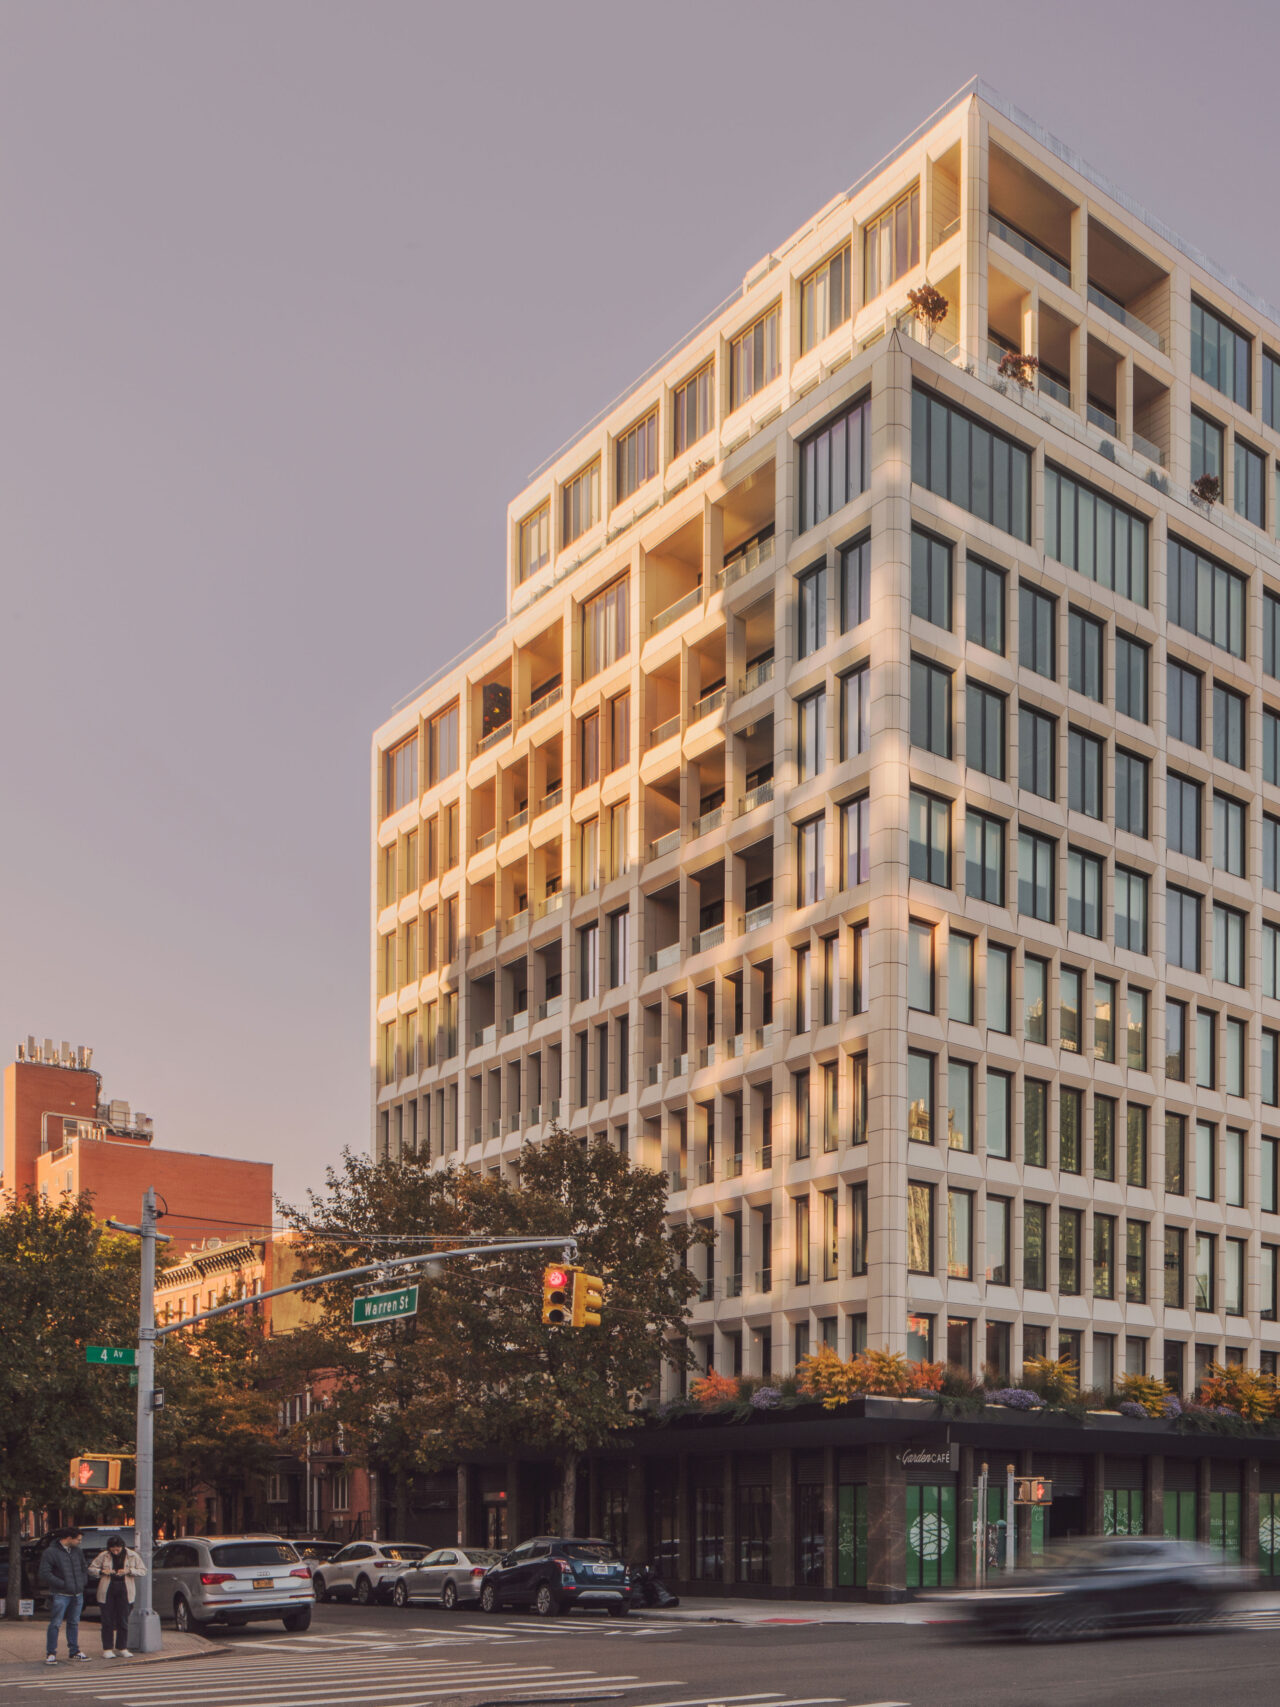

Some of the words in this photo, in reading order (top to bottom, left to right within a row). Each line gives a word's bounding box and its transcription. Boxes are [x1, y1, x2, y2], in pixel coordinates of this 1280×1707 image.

[364, 1300, 397, 1316] Warren
[399, 1295, 409, 1310] St
[100, 1349, 108, 1361] 4
[113, 1349, 124, 1358] Av
